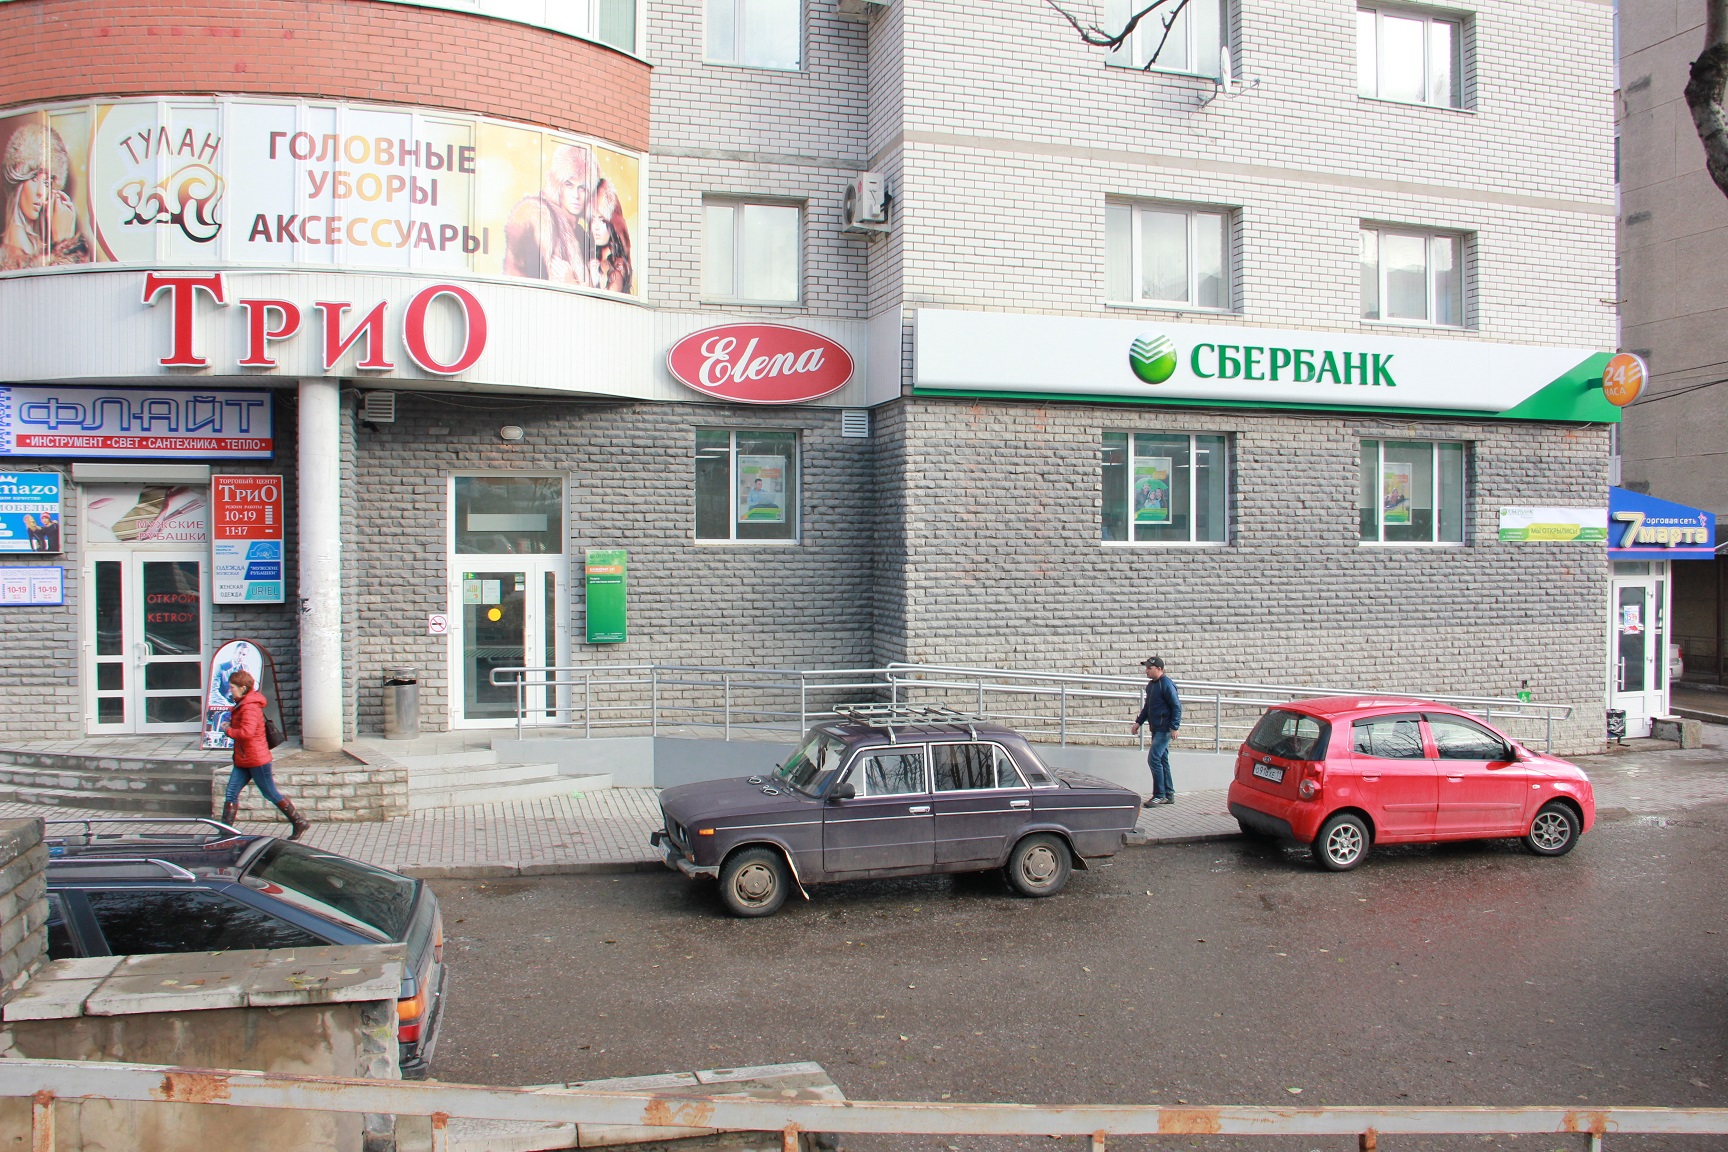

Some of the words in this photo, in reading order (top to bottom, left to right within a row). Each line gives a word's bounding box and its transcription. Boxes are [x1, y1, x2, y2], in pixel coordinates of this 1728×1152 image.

[120, 126, 222, 165] ТУЛАН
[269, 131, 476, 174] ГОЛОВНЫЕ
[306, 169, 438, 206] УБОРЫ
[248, 213, 489, 255] АКСЕССУАРЫ
[698, 335, 826, 387] Elena
[1190, 342, 1397, 387] СБЕРБАНК
[1604, 365, 1626, 386] 24
[19, 396, 264, 433] ФЛАЙТ
[31, 436, 104, 448] ИНСТРУМЕНТ
[112, 437, 140, 448] СВЕТ
[148, 438, 218, 449] САНТЕХНИКА
[226, 439, 260, 450] ТЕПЛО
[137, 520, 204, 529] МУЖСКИЕ
[140, 532, 206, 541] РУБАШКИ
[1612, 511, 1646, 549] 7
[1637, 526, 1709, 548] марта
[1679, 517, 1697, 525] сеть
[251, 586, 279, 596] URIEL
[147, 612, 194, 623] KETROY
